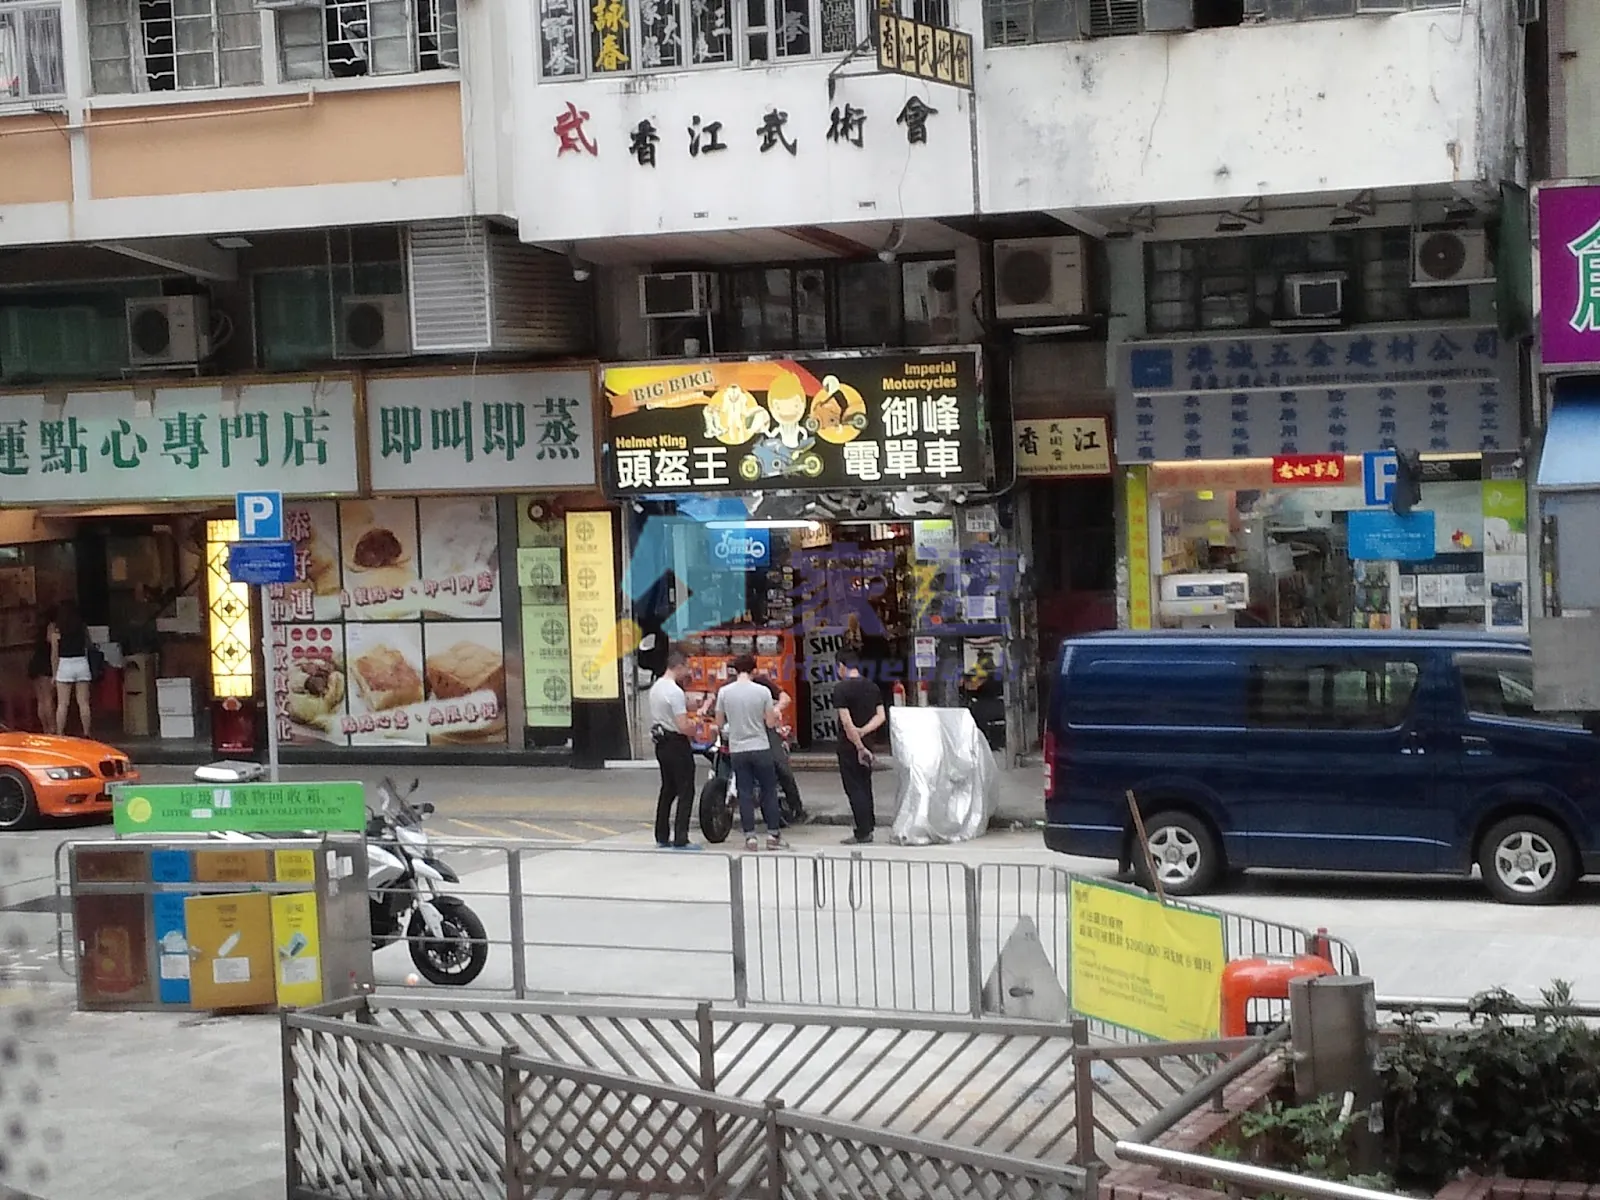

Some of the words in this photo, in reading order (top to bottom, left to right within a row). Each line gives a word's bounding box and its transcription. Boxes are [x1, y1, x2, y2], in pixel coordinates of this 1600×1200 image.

[882, 19, 967, 80] 香江武術會
[629, 95, 939, 169] 香江武術會
[633, 383, 665, 402] BIG
[669, 370, 713, 393] BIKE
[882, 376, 957, 391] Motorcycles
[904, 361, 956, 376] Imperial
[380, 397, 581, 465] 即叫即蒸
[881, 395, 961, 437] 御峰
[0, 406, 332, 476] 運點心專門店
[615, 436, 657, 449] Helmet
[658, 435, 687, 449] King
[842, 438, 963, 481] 電單車
[616, 446, 730, 489] 頭盔王
[244, 495, 274, 536] P
